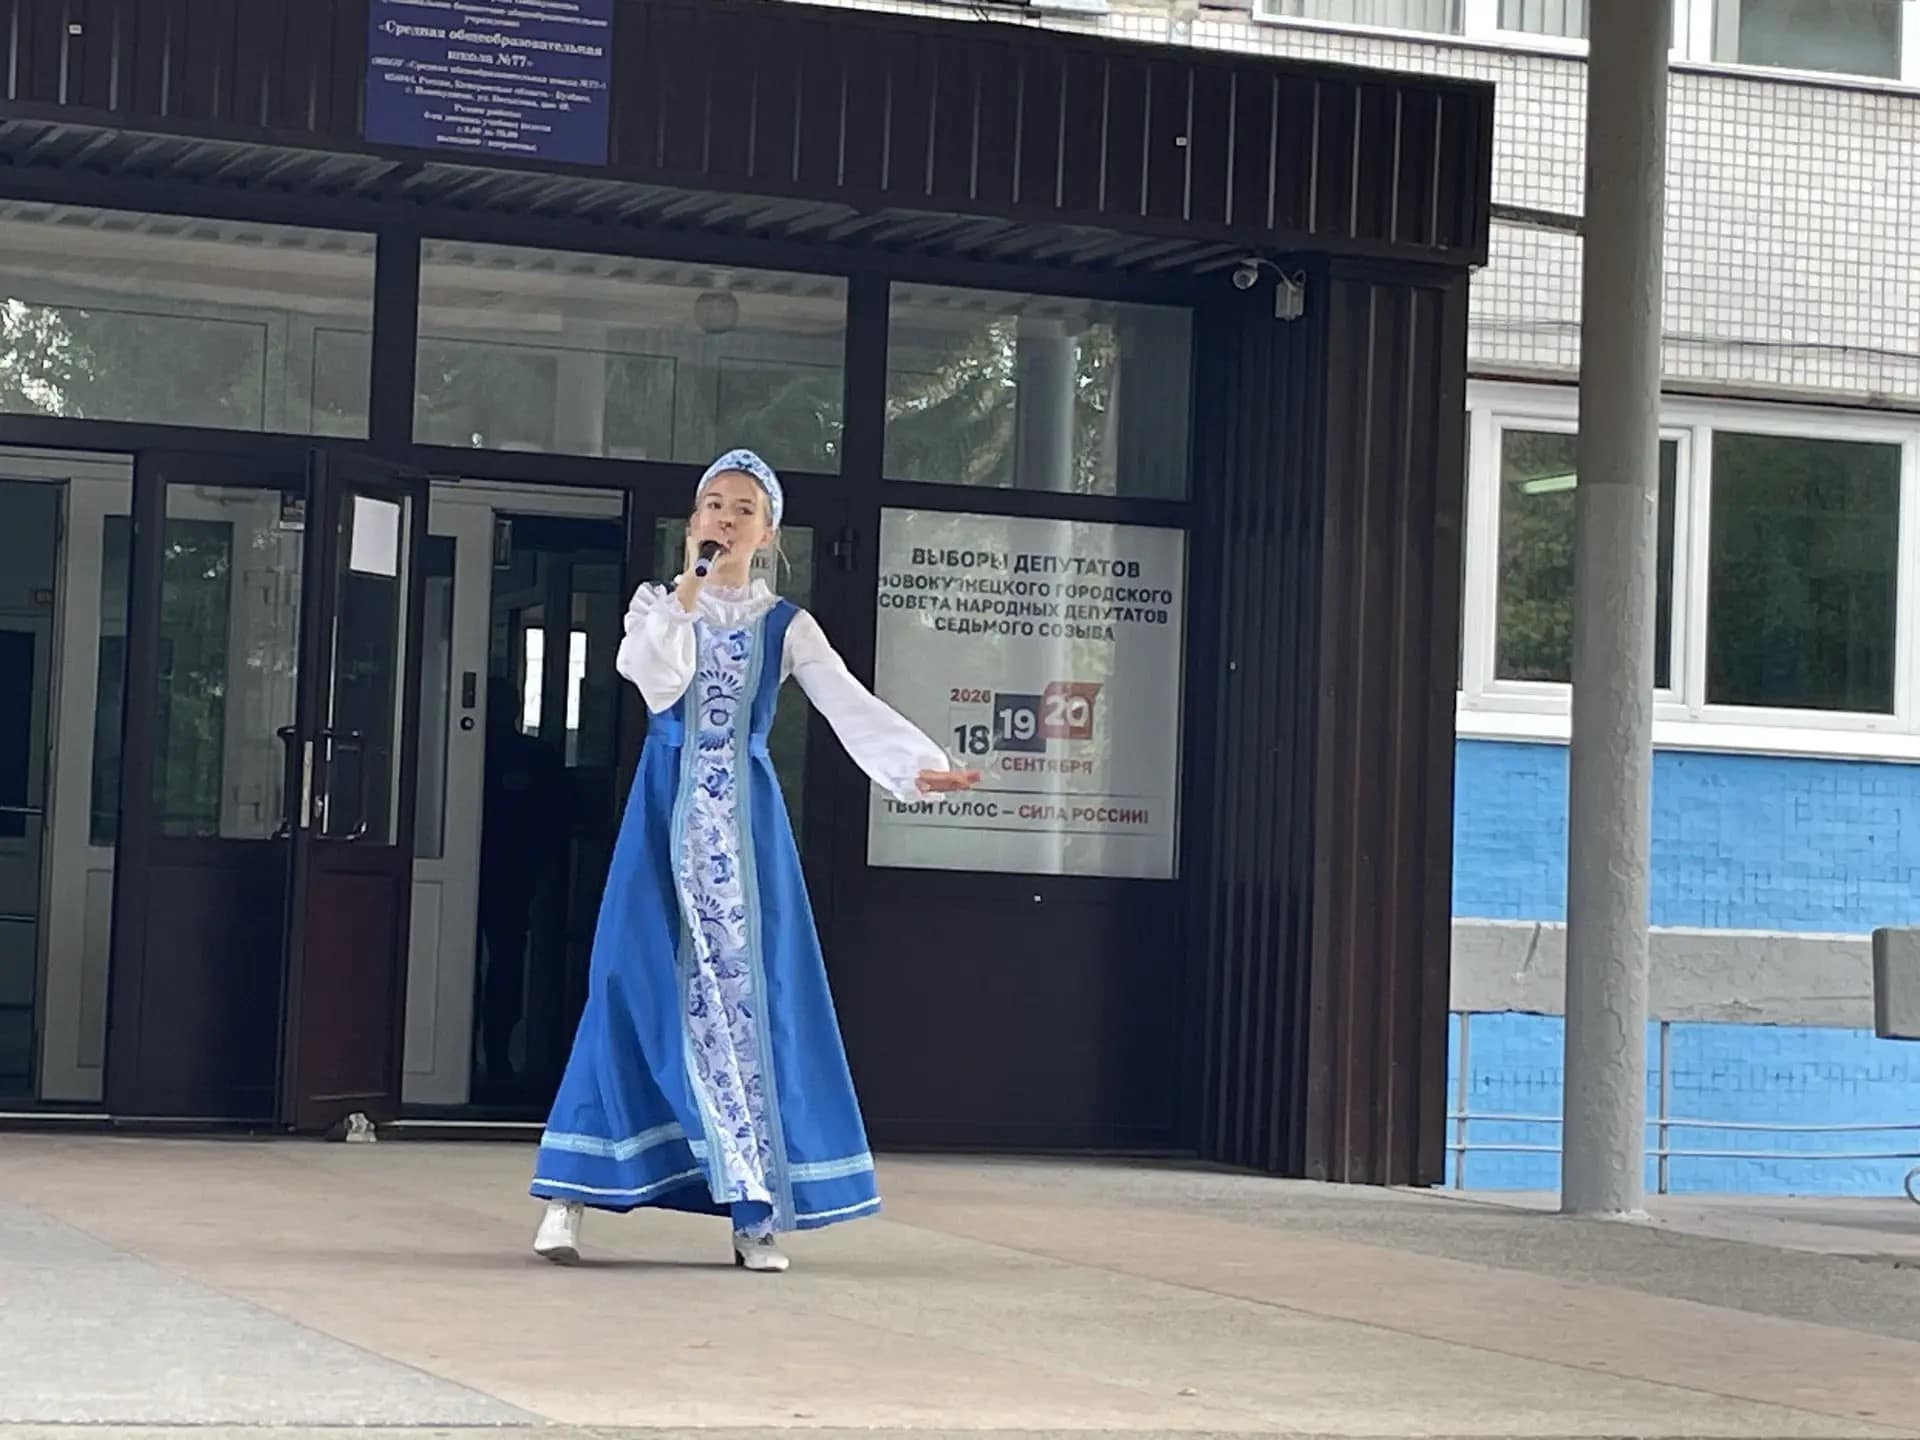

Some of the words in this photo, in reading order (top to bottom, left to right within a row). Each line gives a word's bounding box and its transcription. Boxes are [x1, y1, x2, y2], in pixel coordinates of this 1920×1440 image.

[911, 547, 1008, 570] ВЫБОРЫ
[1014, 554, 1140, 578] ДЕПУТАТОВ
[1055, 583, 1173, 605] ГОРОДСКОГО
[879, 593, 952, 611] СОВЕТА
[956, 598, 1059, 617] НАРОДНЫХ
[1064, 604, 1168, 624] ДЕПУТАТОВ
[935, 617, 1033, 636] СЕДЬМОГО
[1038, 622, 1116, 641] СОЗЫВА
[954, 724, 990, 755] 18
[999, 708, 1036, 740] 19
[1044, 694, 1090, 728] 20
[1001, 757, 1093, 775] СЕНТЯБРЯ
[938, 801, 998, 818] ГОЛОС
[1018, 804, 1068, 821] СИЛА
